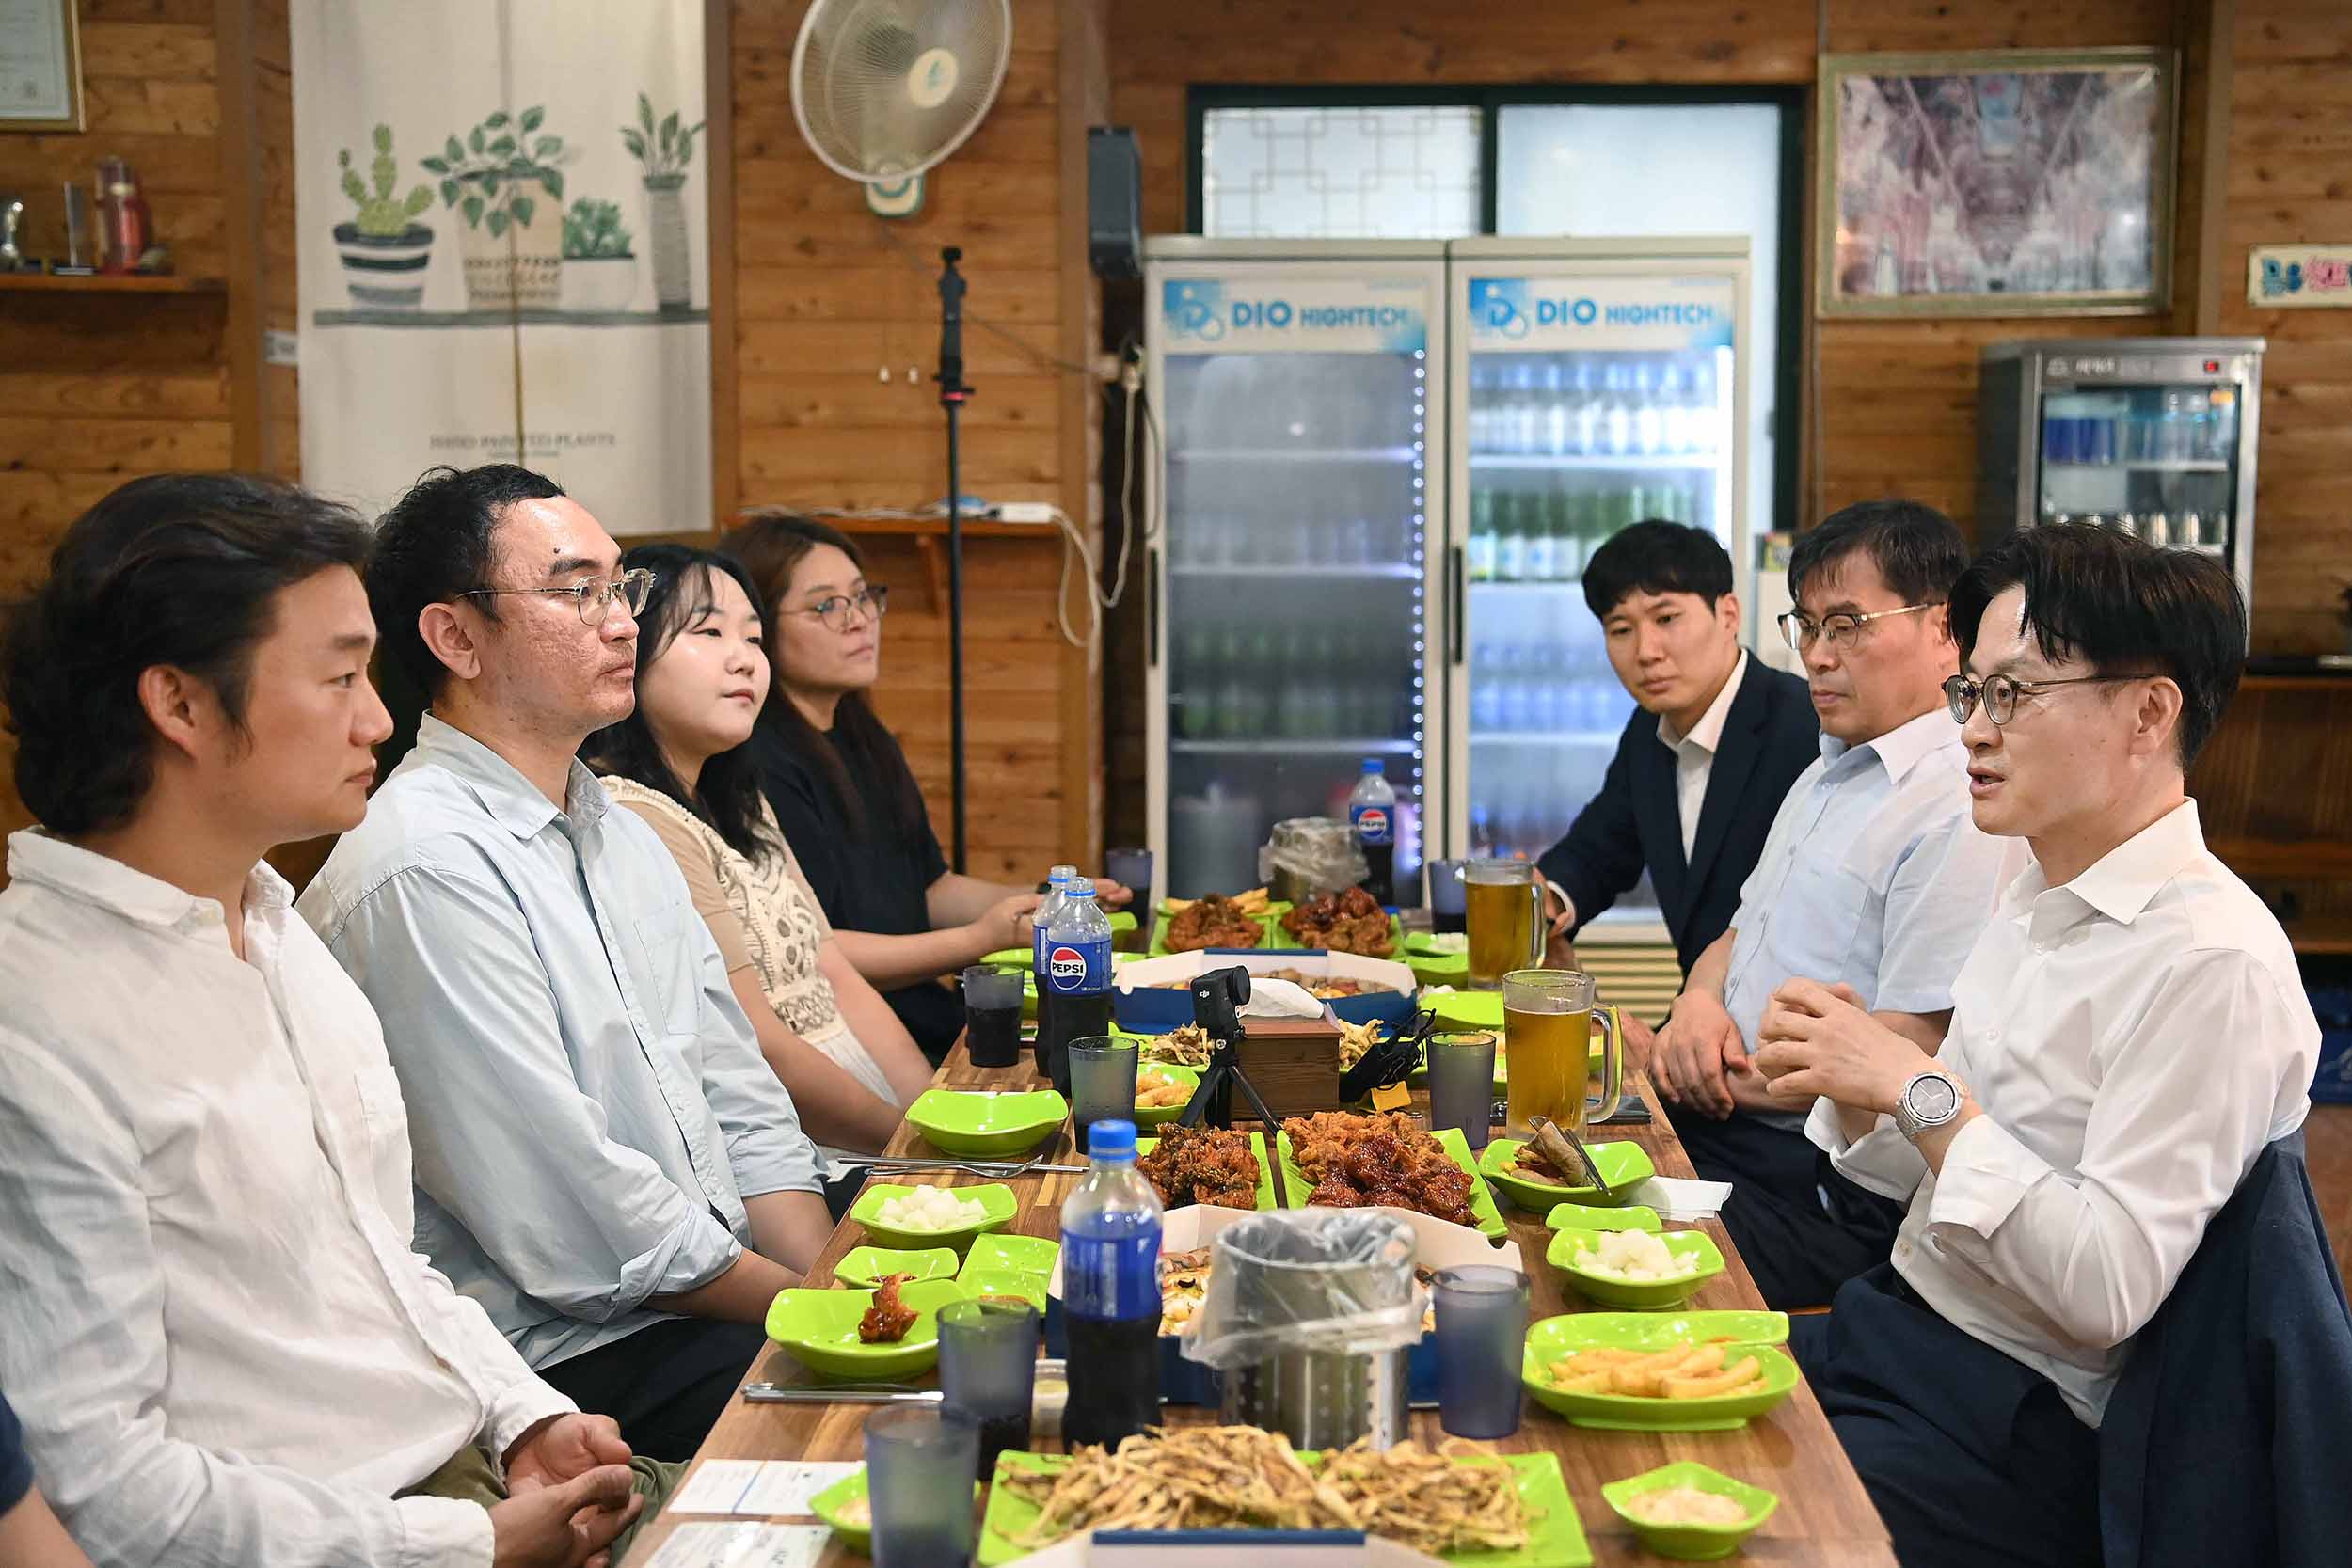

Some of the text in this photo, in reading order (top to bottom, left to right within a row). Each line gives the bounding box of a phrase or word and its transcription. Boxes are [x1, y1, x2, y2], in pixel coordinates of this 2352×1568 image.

[1232, 300, 1407, 327] DIO HIGHTECH
[1536, 298, 1713, 325] DIO HIGHTECH
[1053, 963, 1084, 974] PEPSI
